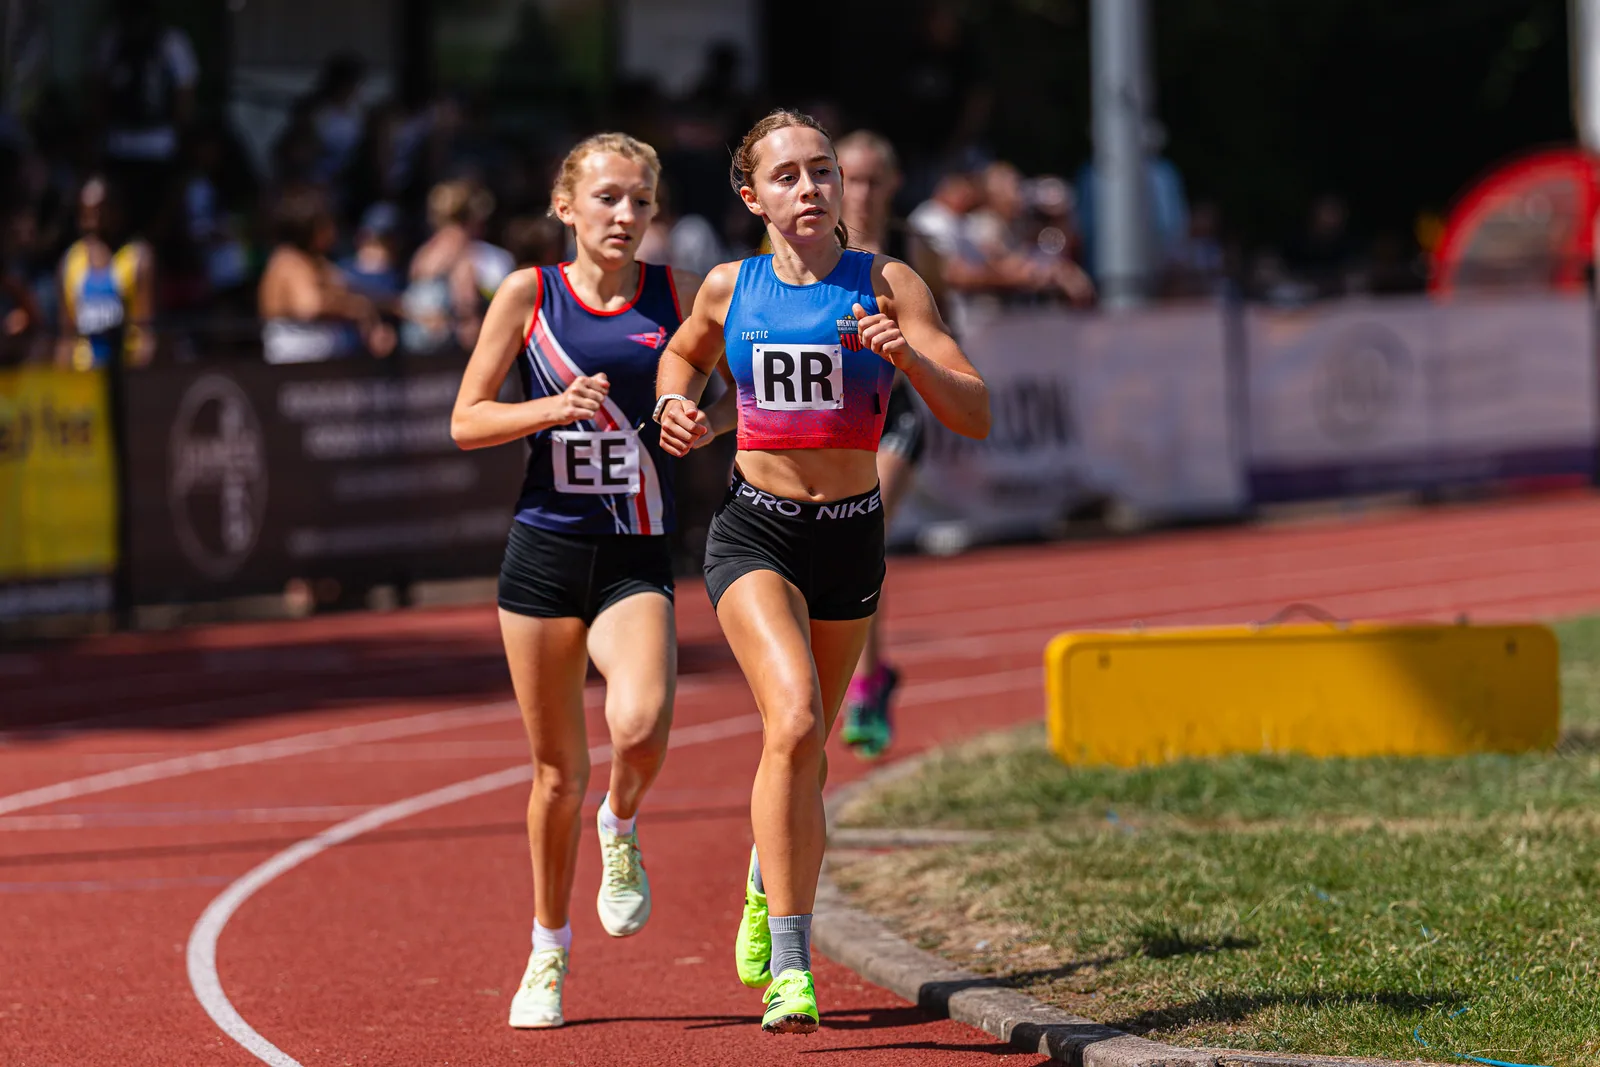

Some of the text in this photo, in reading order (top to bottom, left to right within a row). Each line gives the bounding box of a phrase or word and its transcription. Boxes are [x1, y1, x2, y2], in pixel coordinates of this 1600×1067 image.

[741, 330, 769, 341] TACTIC
[763, 351, 834, 402] RR
[566, 438, 629, 486] EE
[735, 482, 802, 517] PRO
[815, 490, 880, 520] NIKE
